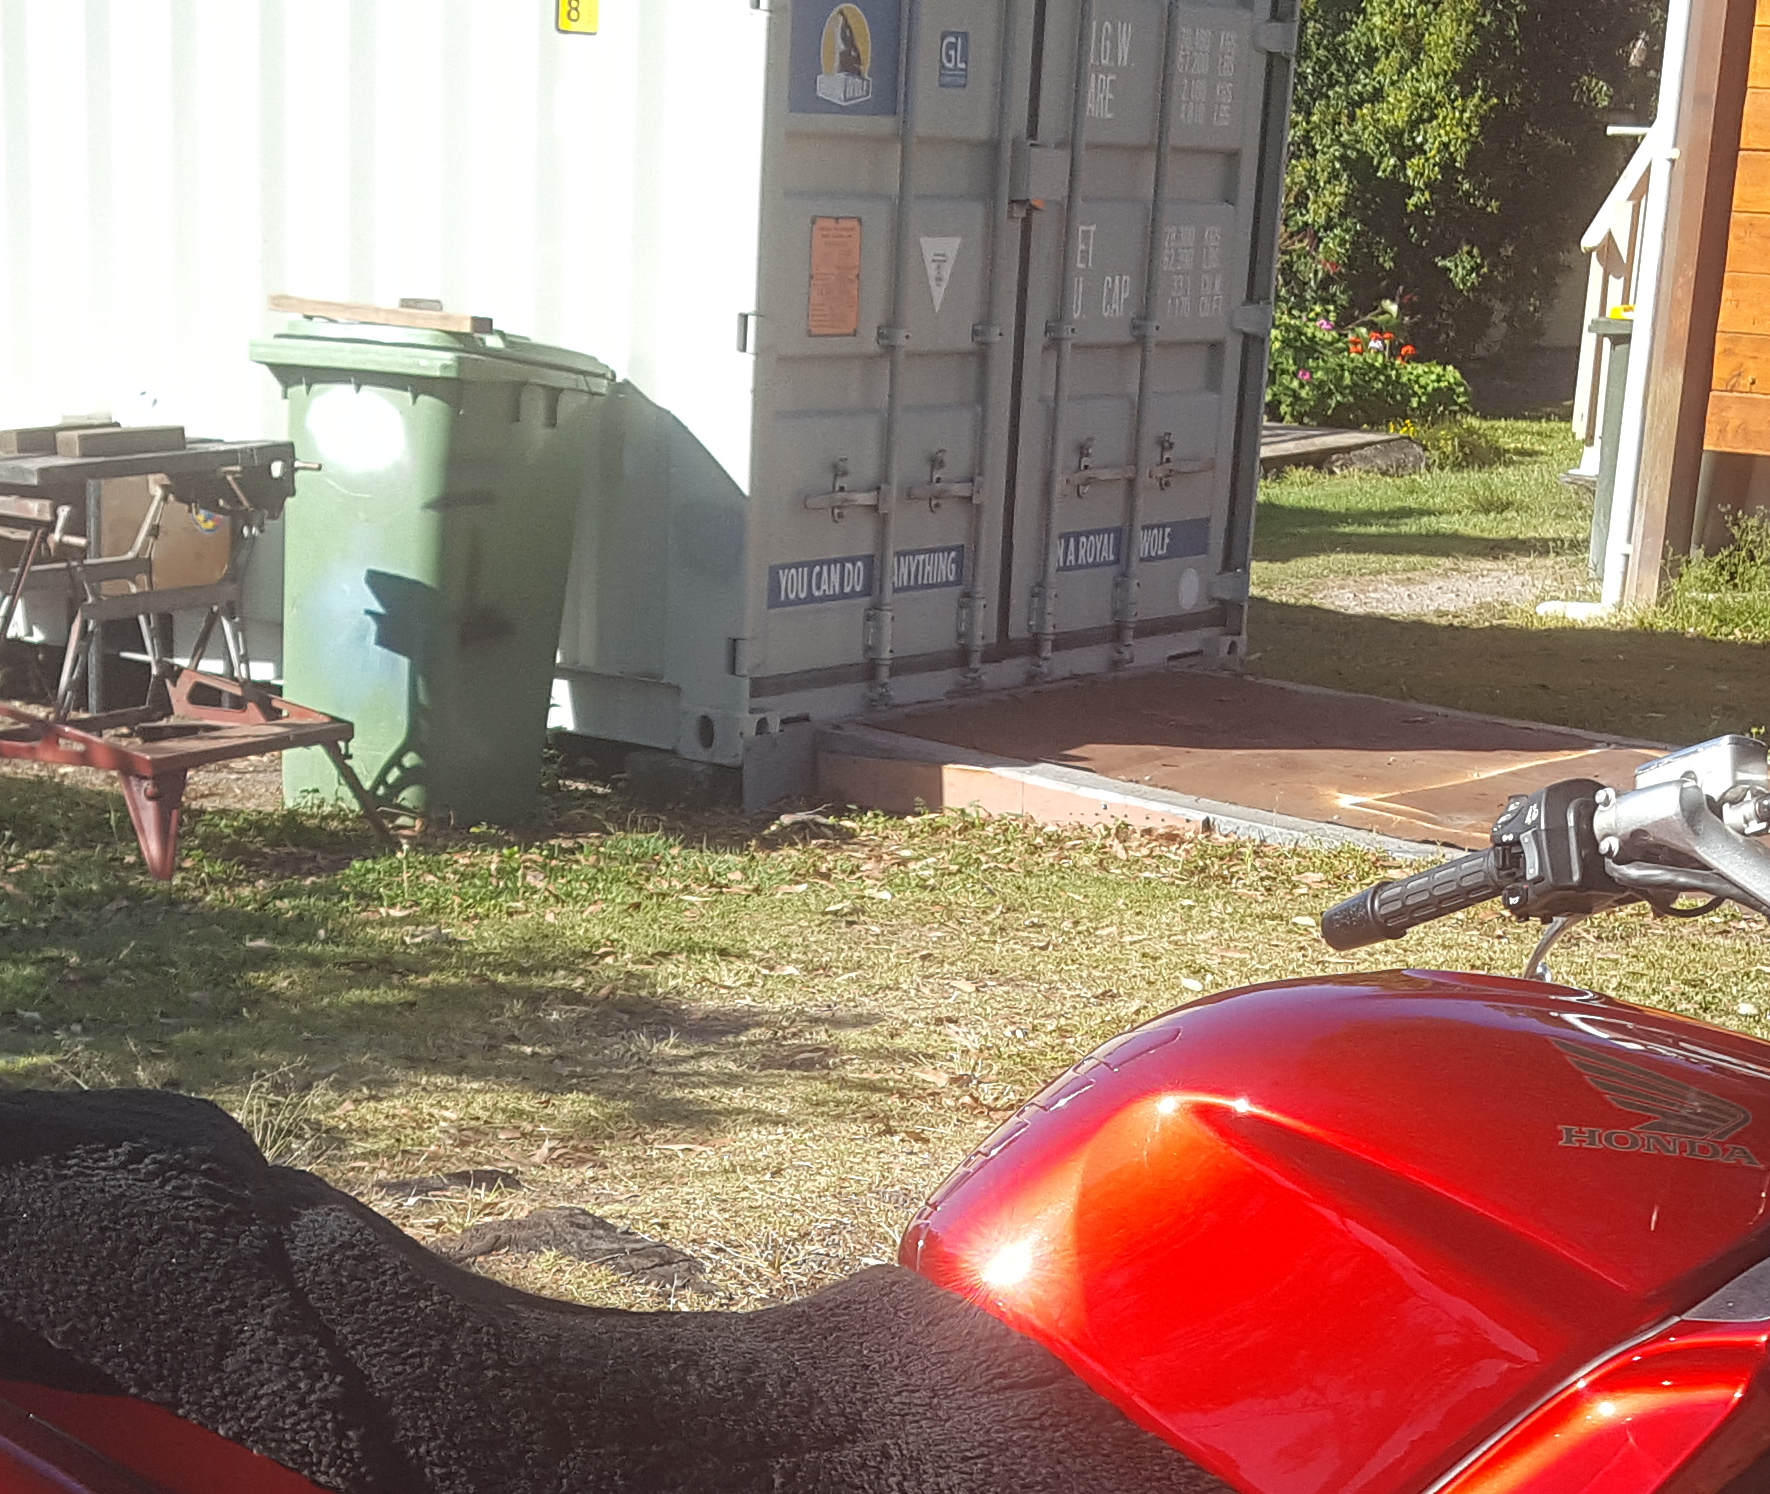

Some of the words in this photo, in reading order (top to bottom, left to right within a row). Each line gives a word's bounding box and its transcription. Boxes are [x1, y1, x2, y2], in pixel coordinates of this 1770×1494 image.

[941, 36, 967, 69] GL
[1086, 73, 1116, 119] ARE
[1076, 224, 1097, 269] ET
[1072, 276, 1086, 319] U.
[778, 567, 808, 601] YOU
[811, 563, 841, 597] CAN
[843, 560, 864, 593] DO
[892, 551, 957, 588] ANYTHING
[1078, 532, 1115, 565] ROYAL
[1140, 527, 1172, 558] WOLF
[1557, 1124, 1767, 1171] HONDA
